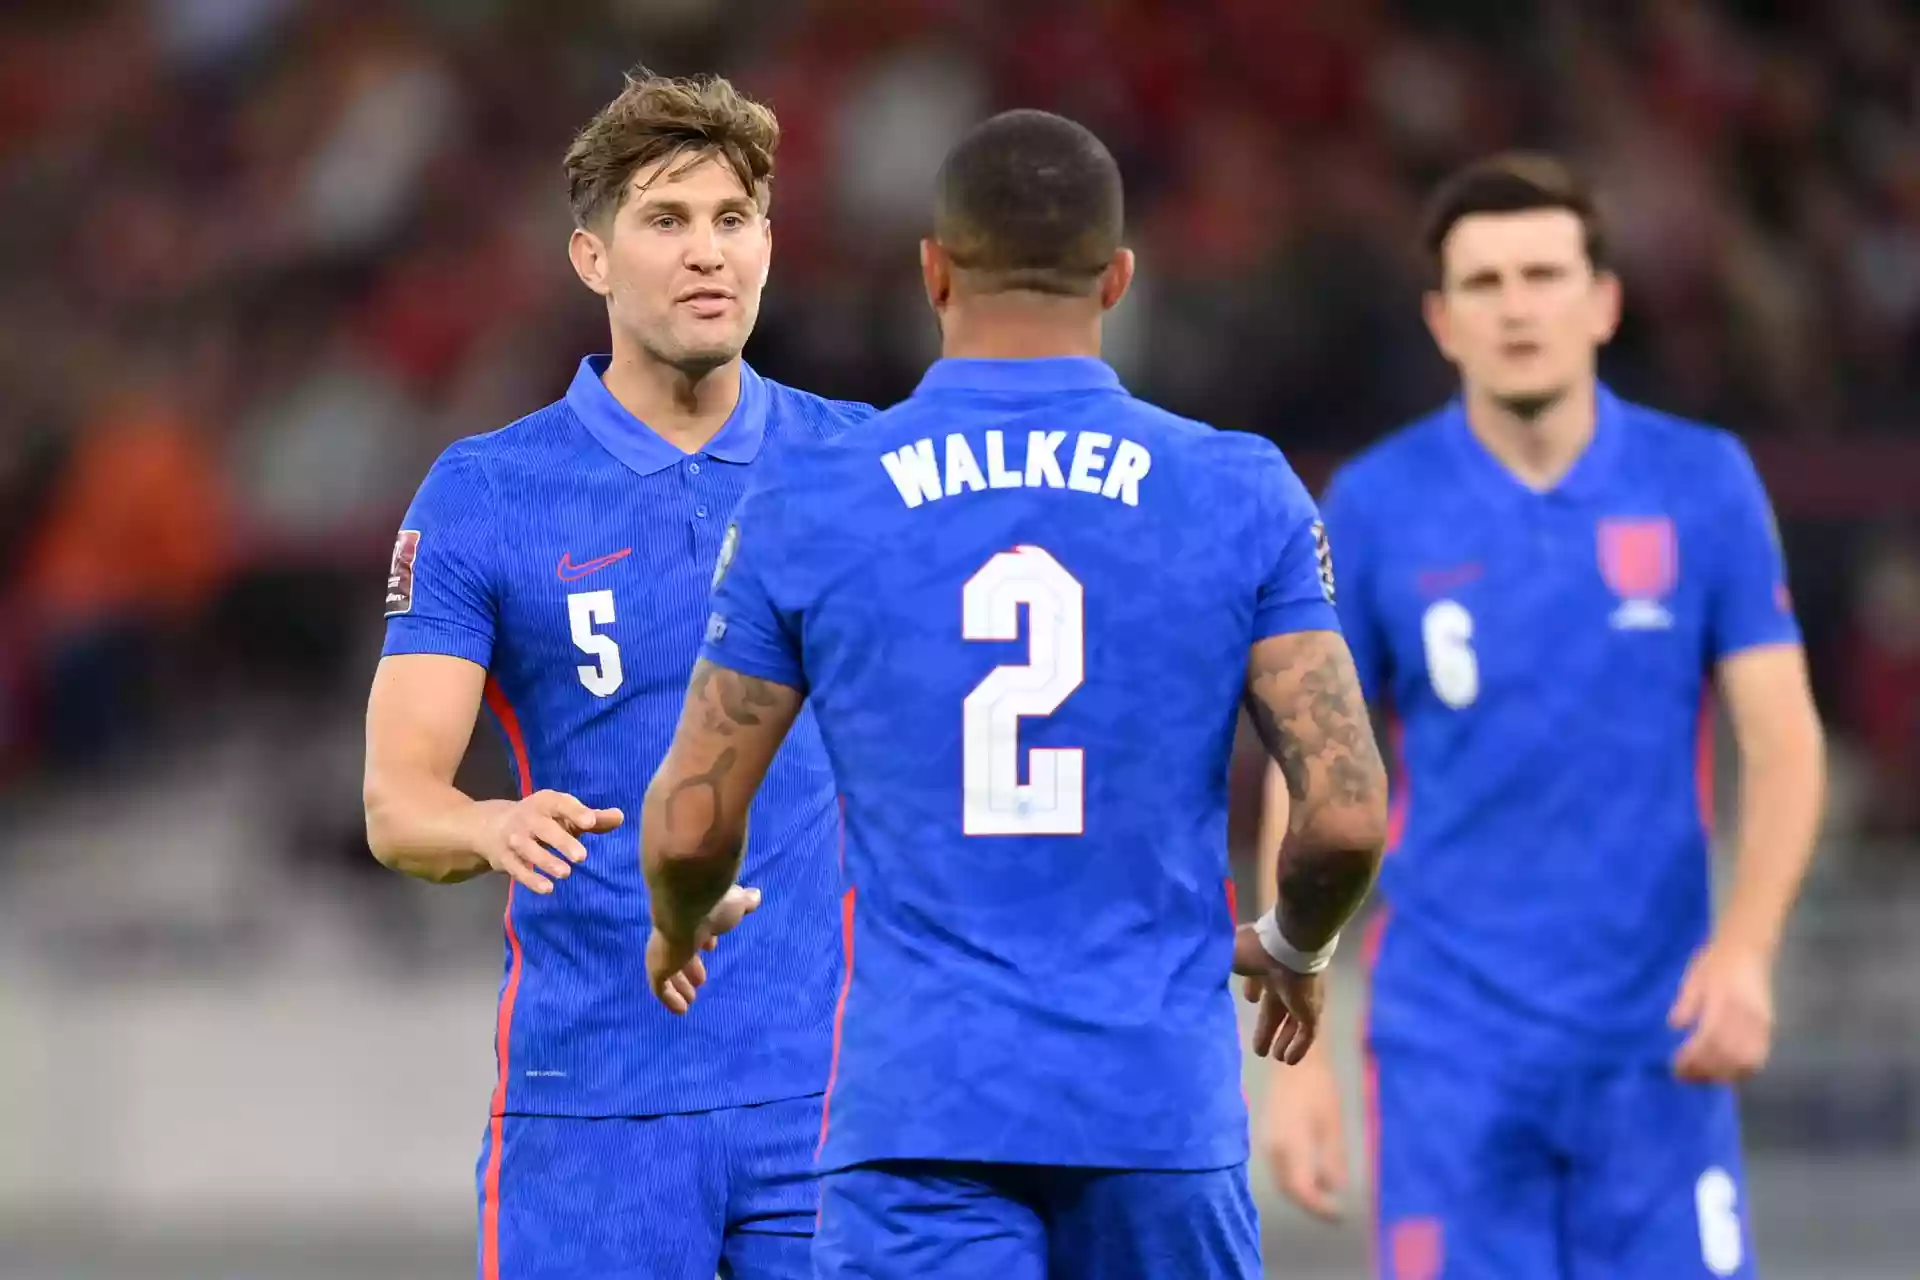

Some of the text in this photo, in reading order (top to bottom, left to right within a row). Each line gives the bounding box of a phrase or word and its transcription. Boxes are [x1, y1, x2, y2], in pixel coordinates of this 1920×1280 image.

[881, 429, 1152, 509] WALKER
[567, 589, 624, 698] 5
[962, 544, 1084, 836] 2
[1423, 599, 1478, 708] 6
[1695, 1167, 1745, 1277] 6
